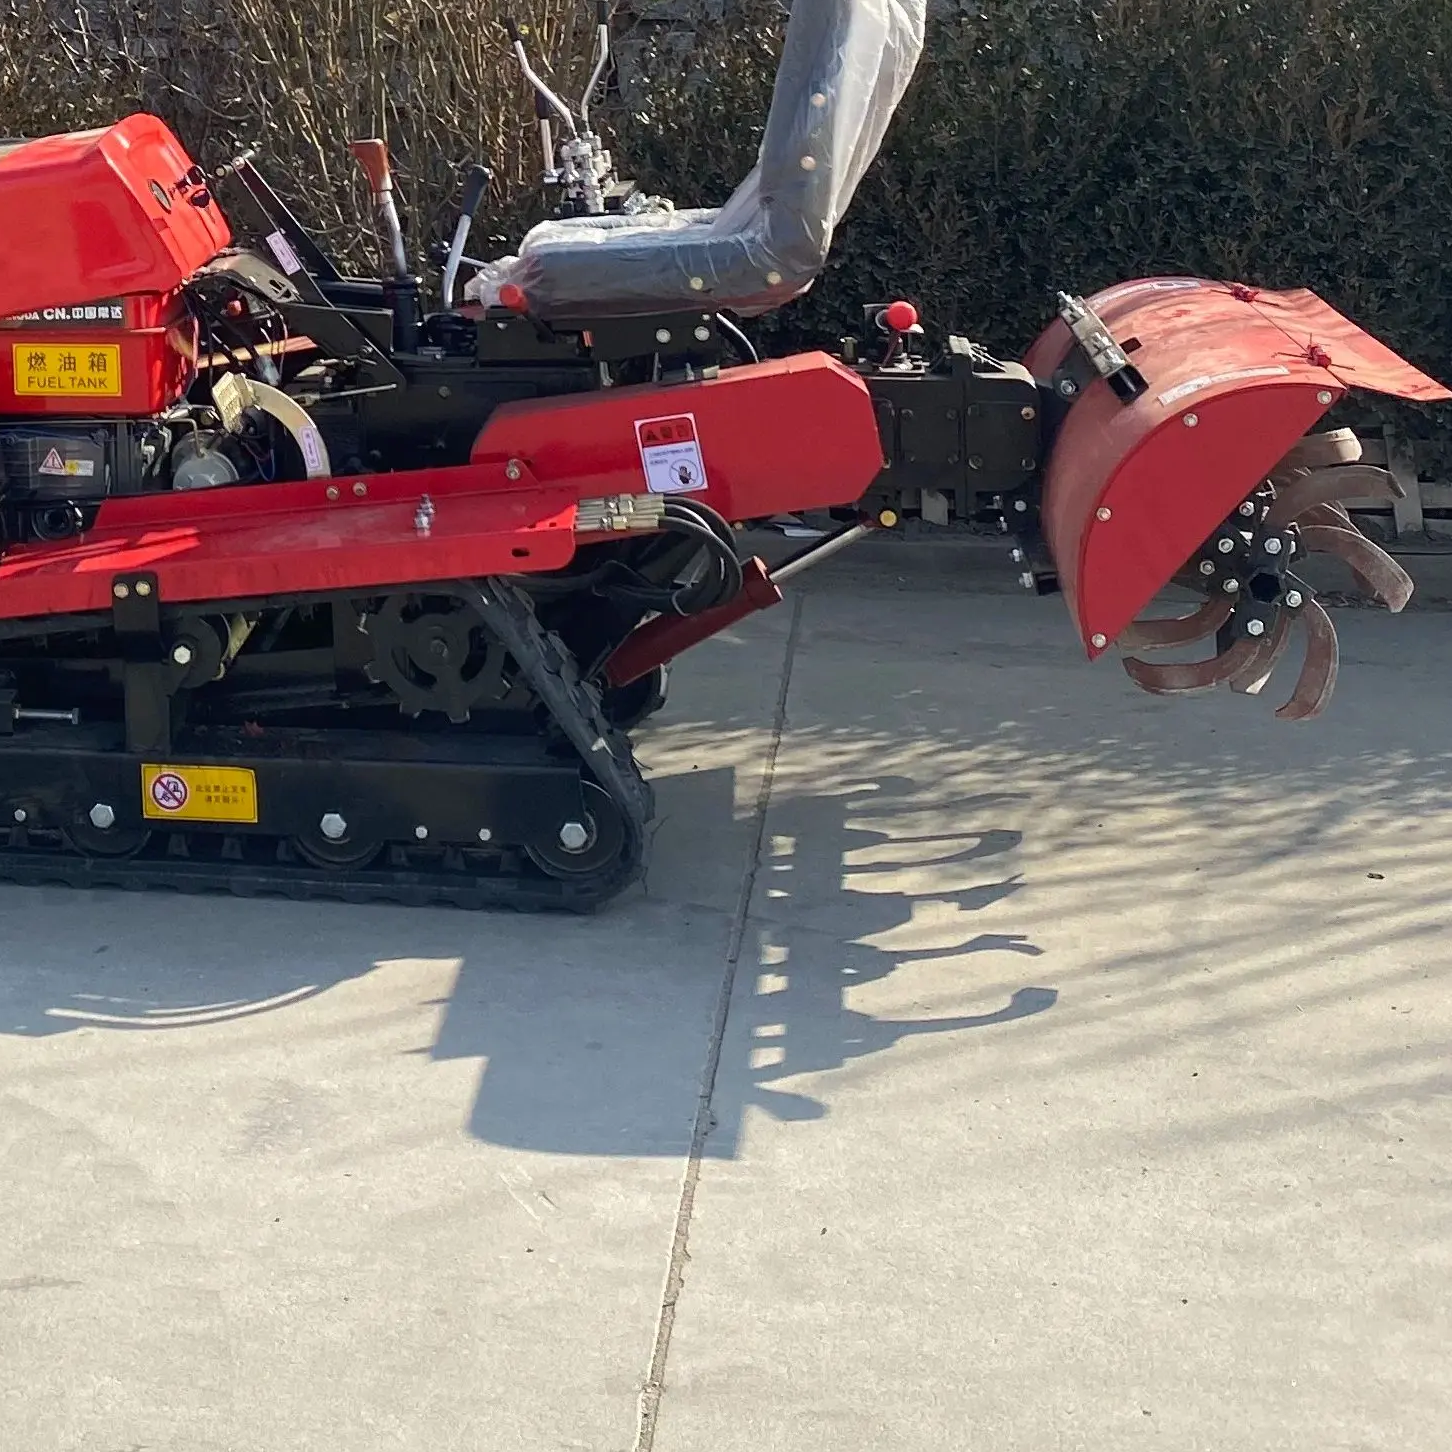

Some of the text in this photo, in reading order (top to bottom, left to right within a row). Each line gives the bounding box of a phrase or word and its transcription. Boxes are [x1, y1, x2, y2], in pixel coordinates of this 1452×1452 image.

[27, 351, 108, 373] 燃油箱
[27, 376, 108, 389] FUEL TANK
